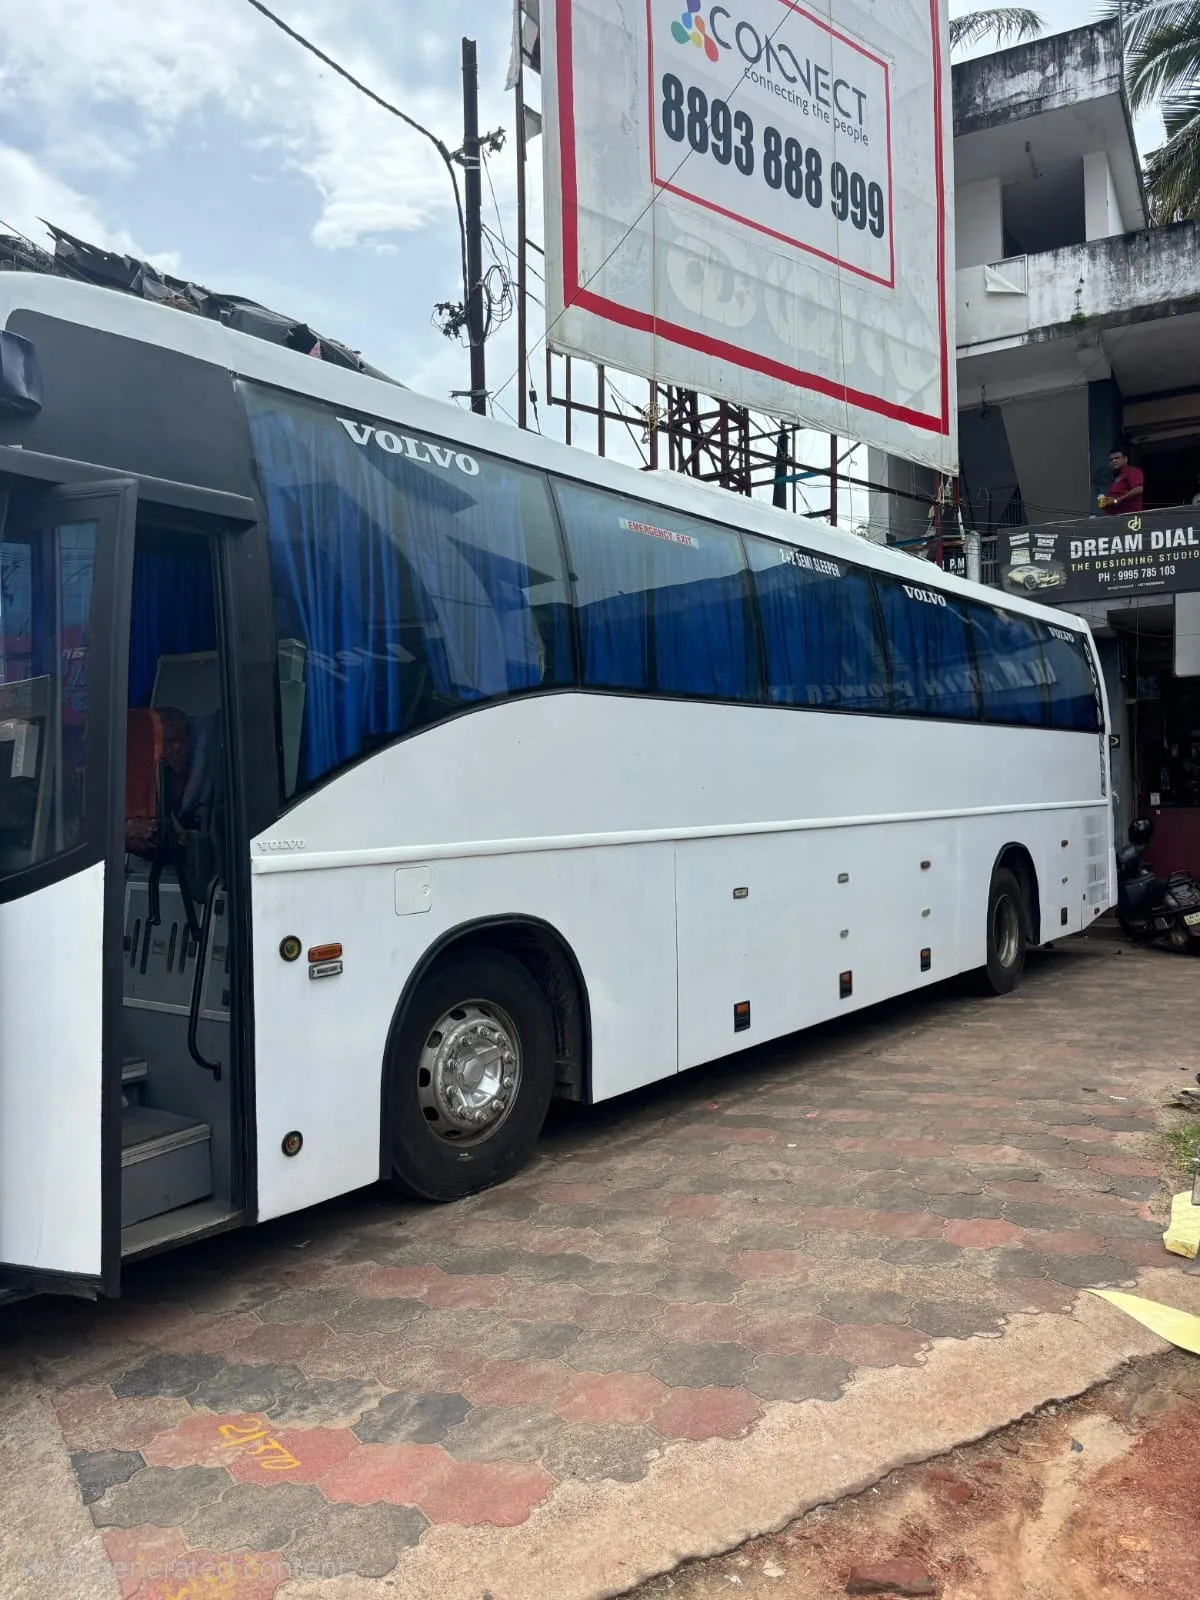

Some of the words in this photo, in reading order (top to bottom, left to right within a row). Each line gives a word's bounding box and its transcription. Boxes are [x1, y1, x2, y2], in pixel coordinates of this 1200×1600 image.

[709, 5, 867, 126] CONNECT
[744, 67, 809, 116] connecting
[812, 102, 830, 124] the
[833, 115, 869, 146] people
[661, 72, 754, 176] 8893
[763, 126, 822, 209] 888
[830, 161, 884, 239] 999
[335, 416, 480, 476] VOLVO
[627, 520, 673, 541] EMERGENCY
[676, 533, 693, 545] EXIT
[1070, 533, 1143, 559] DREAM
[1150, 526, 1200, 550] DIAL
[796, 552, 813, 571] SEMI
[813, 557, 841, 578] SLEEPER
[1071, 562, 1090, 572] THE
[1095, 555, 1153, 570] DESIGNING
[1159, 549, 1200, 562] STUDIO
[1098, 572, 1111, 583] PH
[1118, 569, 1139, 581] 9995
[1141, 567, 1157, 578] 785
[1160, 565, 1176, 576] 103
[902, 584, 948, 607] VOLVO
[1047, 626, 1075, 643] VOLVO
[256, 839, 306, 852] VOLVO
